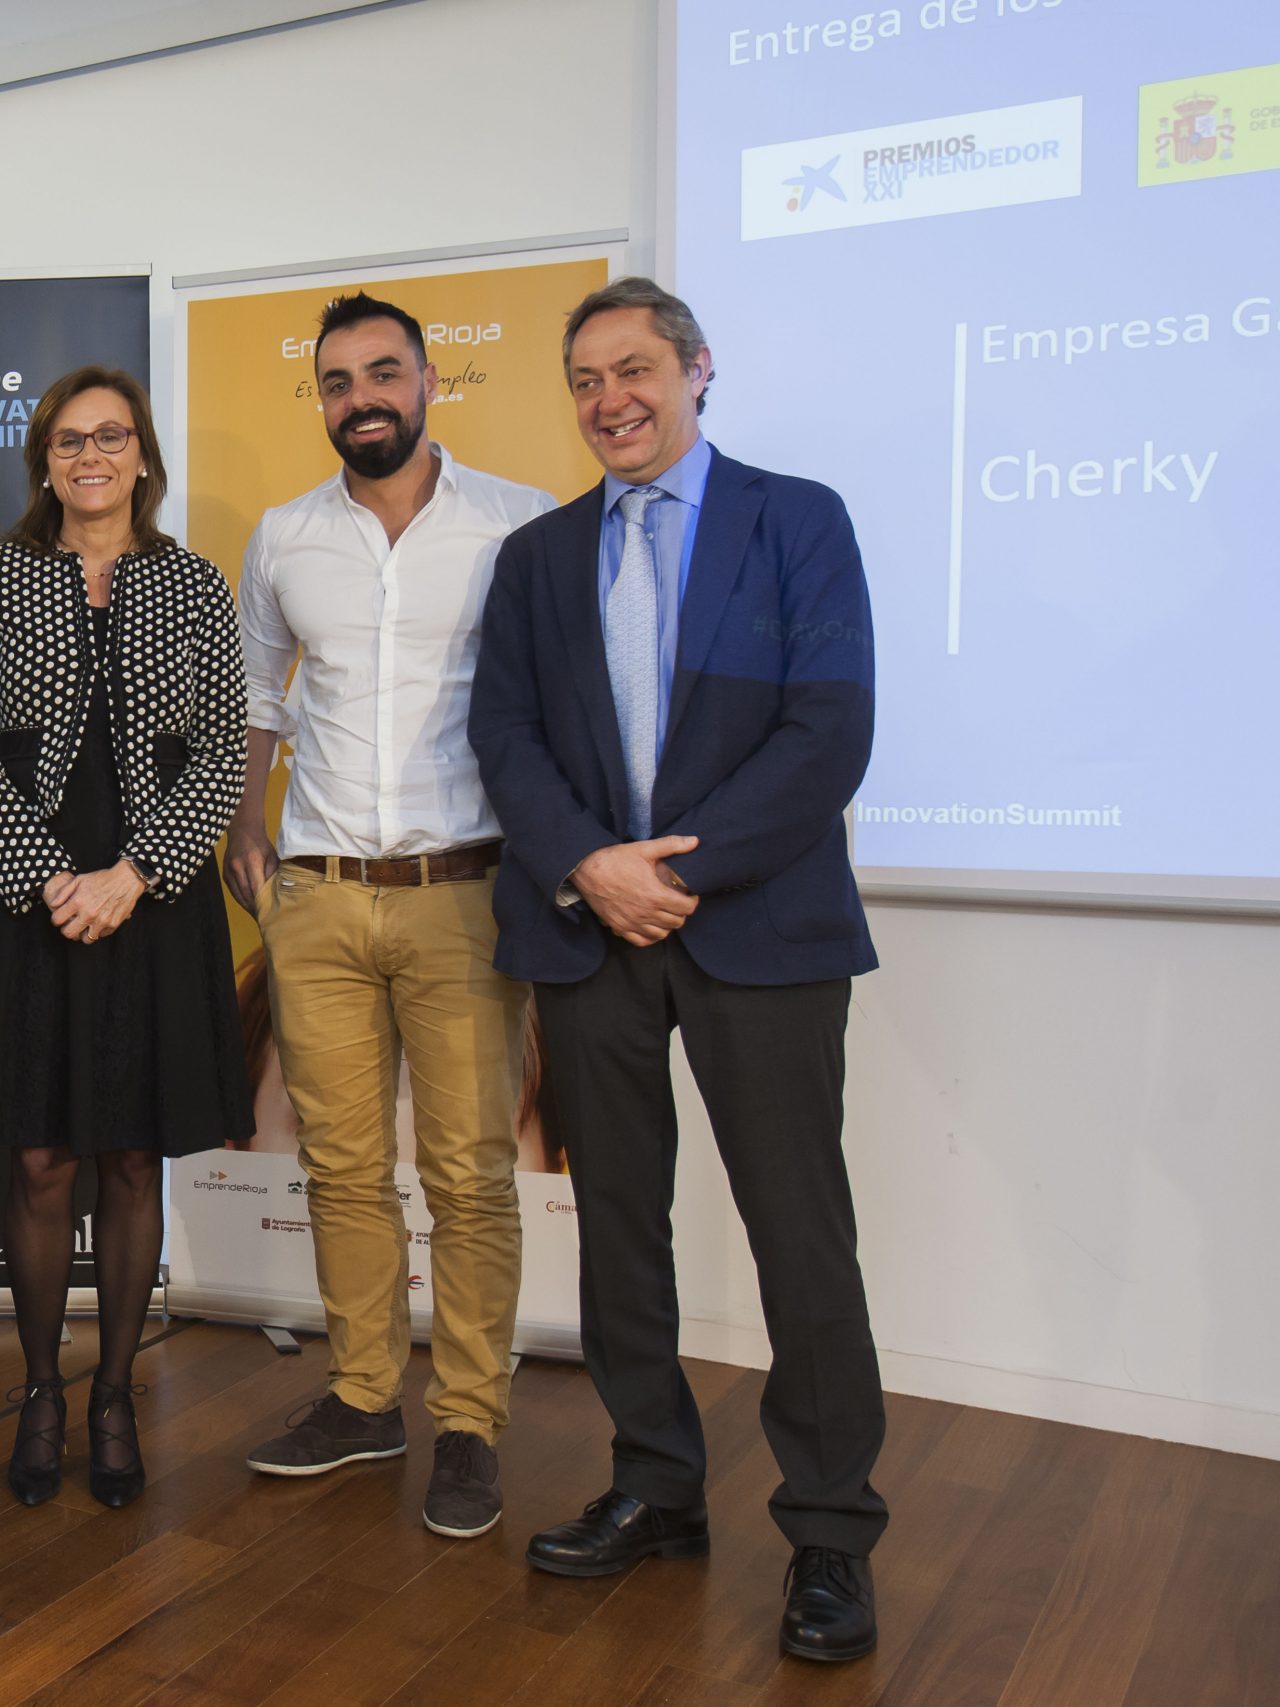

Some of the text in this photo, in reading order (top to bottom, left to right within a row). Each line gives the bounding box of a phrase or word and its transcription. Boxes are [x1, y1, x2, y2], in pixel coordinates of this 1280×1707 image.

[728, 5, 902, 66] Entrega
[862, 134, 977, 169] PREMIOS
[862, 139, 1061, 187] EMPRENDEDOR
[862, 180, 904, 204] XXI
[981, 310, 1210, 365] Empresa
[979, 440, 1219, 503] Cherky
[857, 801, 1123, 828] InnovationSummit
[193, 1181, 268, 1195] EmprendeRioja
